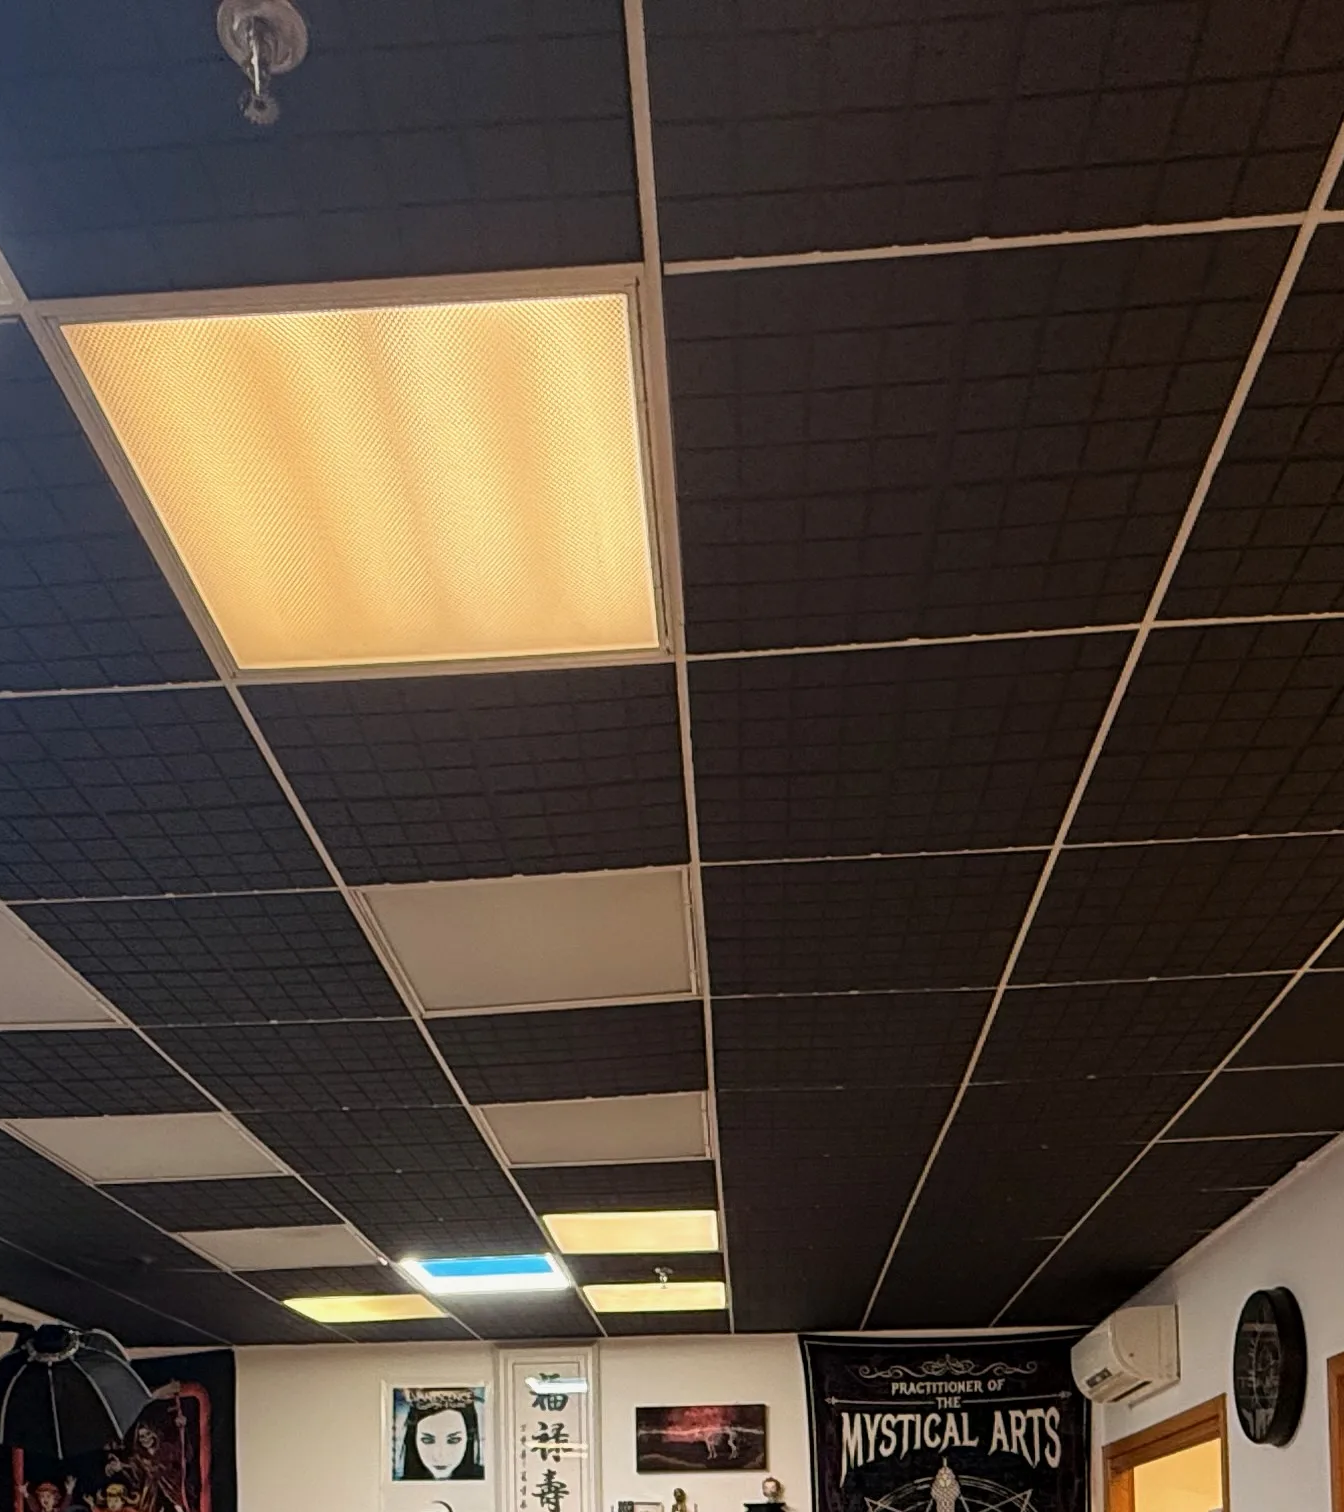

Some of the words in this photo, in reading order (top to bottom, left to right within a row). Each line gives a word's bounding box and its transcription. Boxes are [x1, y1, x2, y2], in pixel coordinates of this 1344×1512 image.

[891, 1381, 983, 1395] PRACTITIONER
[987, 1379, 1005, 1393] OF
[936, 1396, 961, 1409] THE
[840, 1412, 979, 1487] MYSTICAL
[989, 1409, 1061, 1468] ARTS
